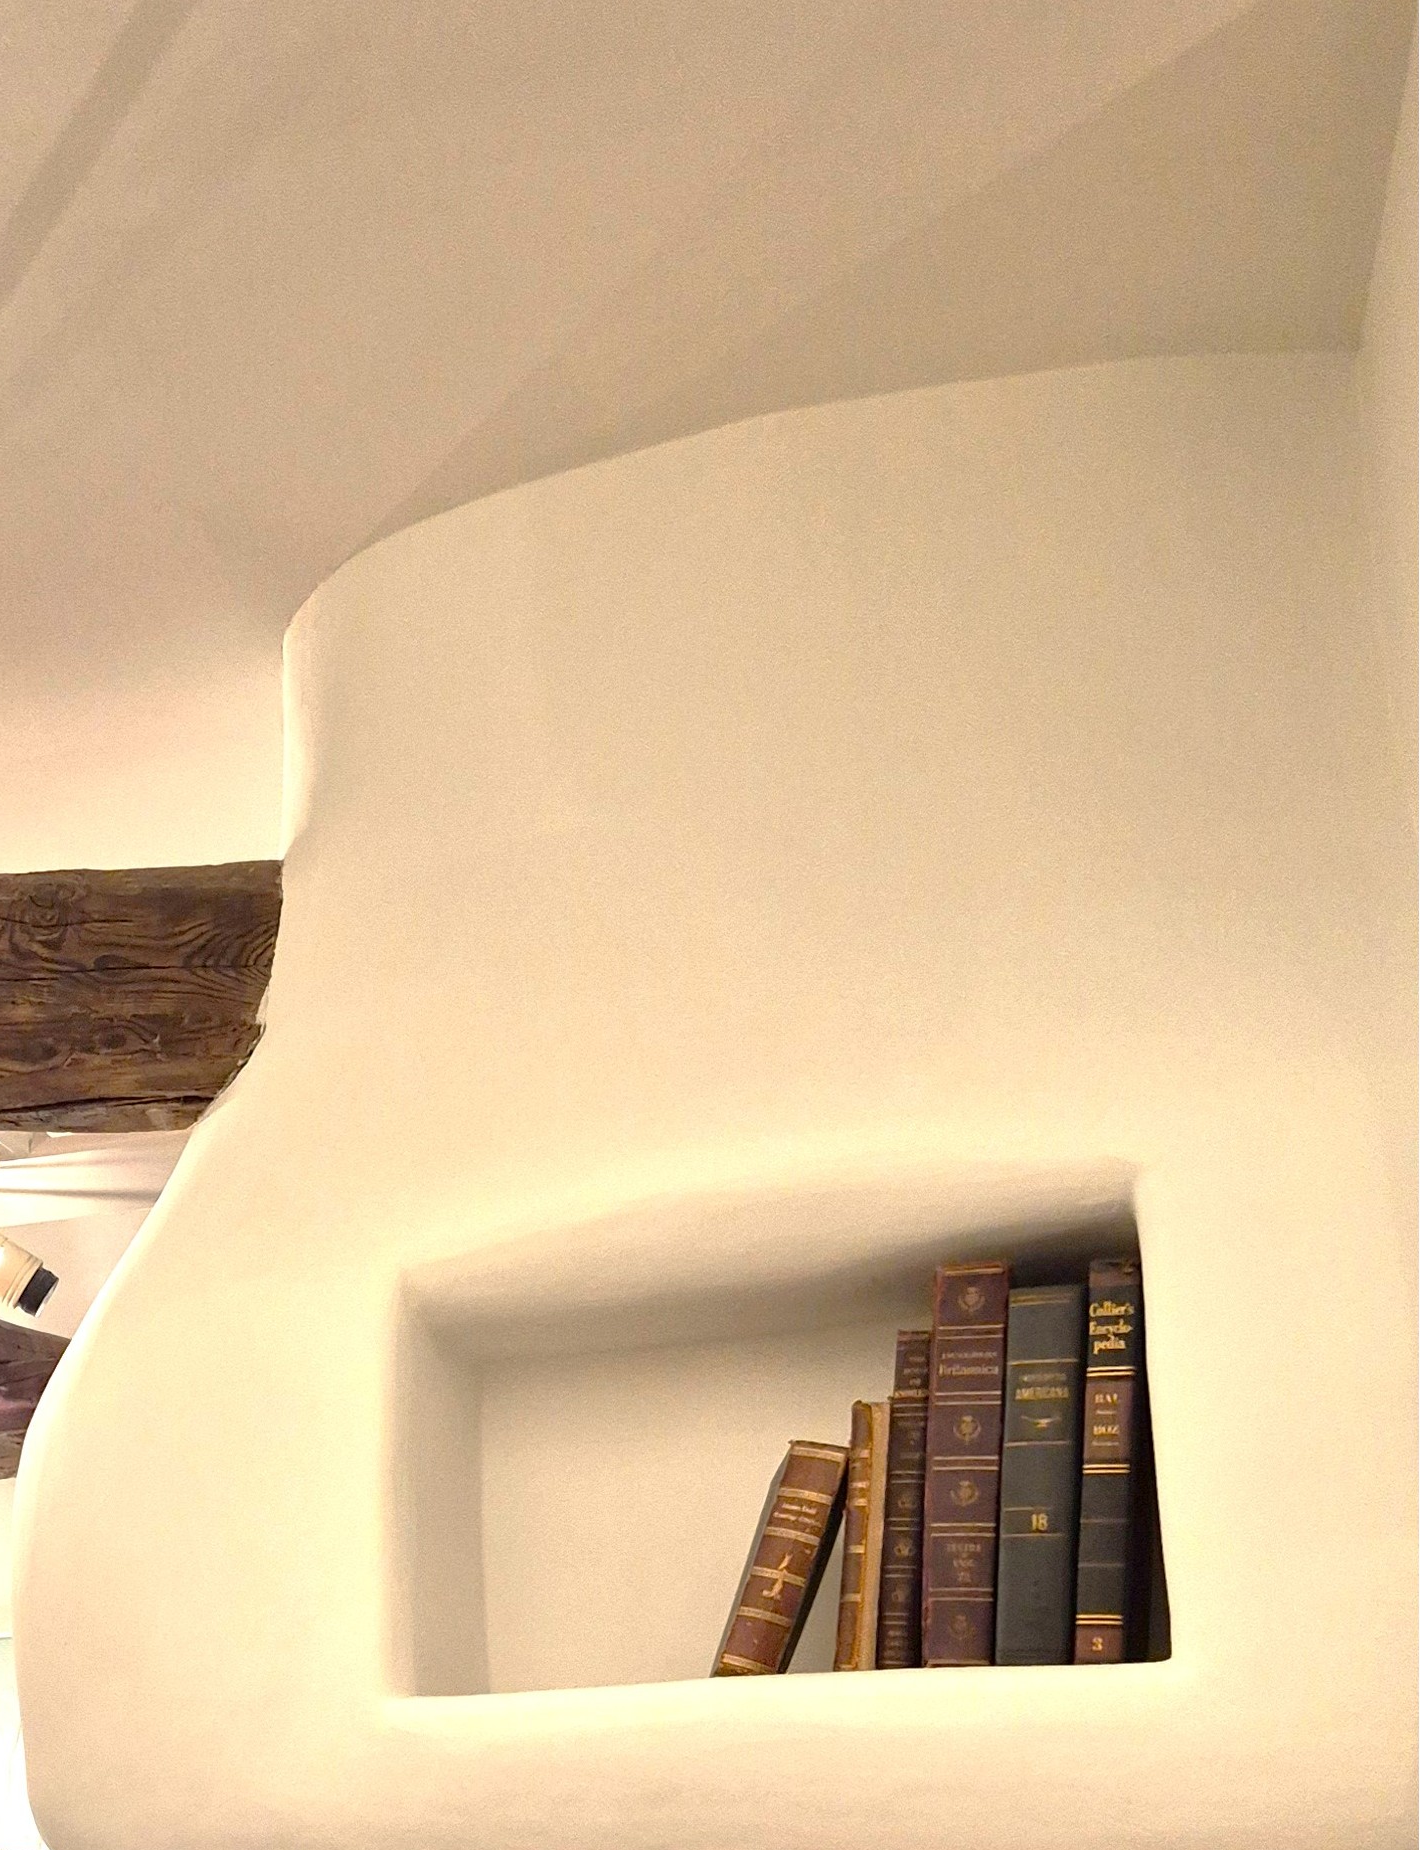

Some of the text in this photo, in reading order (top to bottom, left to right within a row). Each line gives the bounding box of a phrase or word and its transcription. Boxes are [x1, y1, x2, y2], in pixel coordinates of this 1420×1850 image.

[1089, 1300, 1135, 1317] Collier's
[1093, 1337, 1126, 1355] pedia
[1031, 1513, 1049, 1531] 18
[1091, 1637, 1103, 1651] 3
